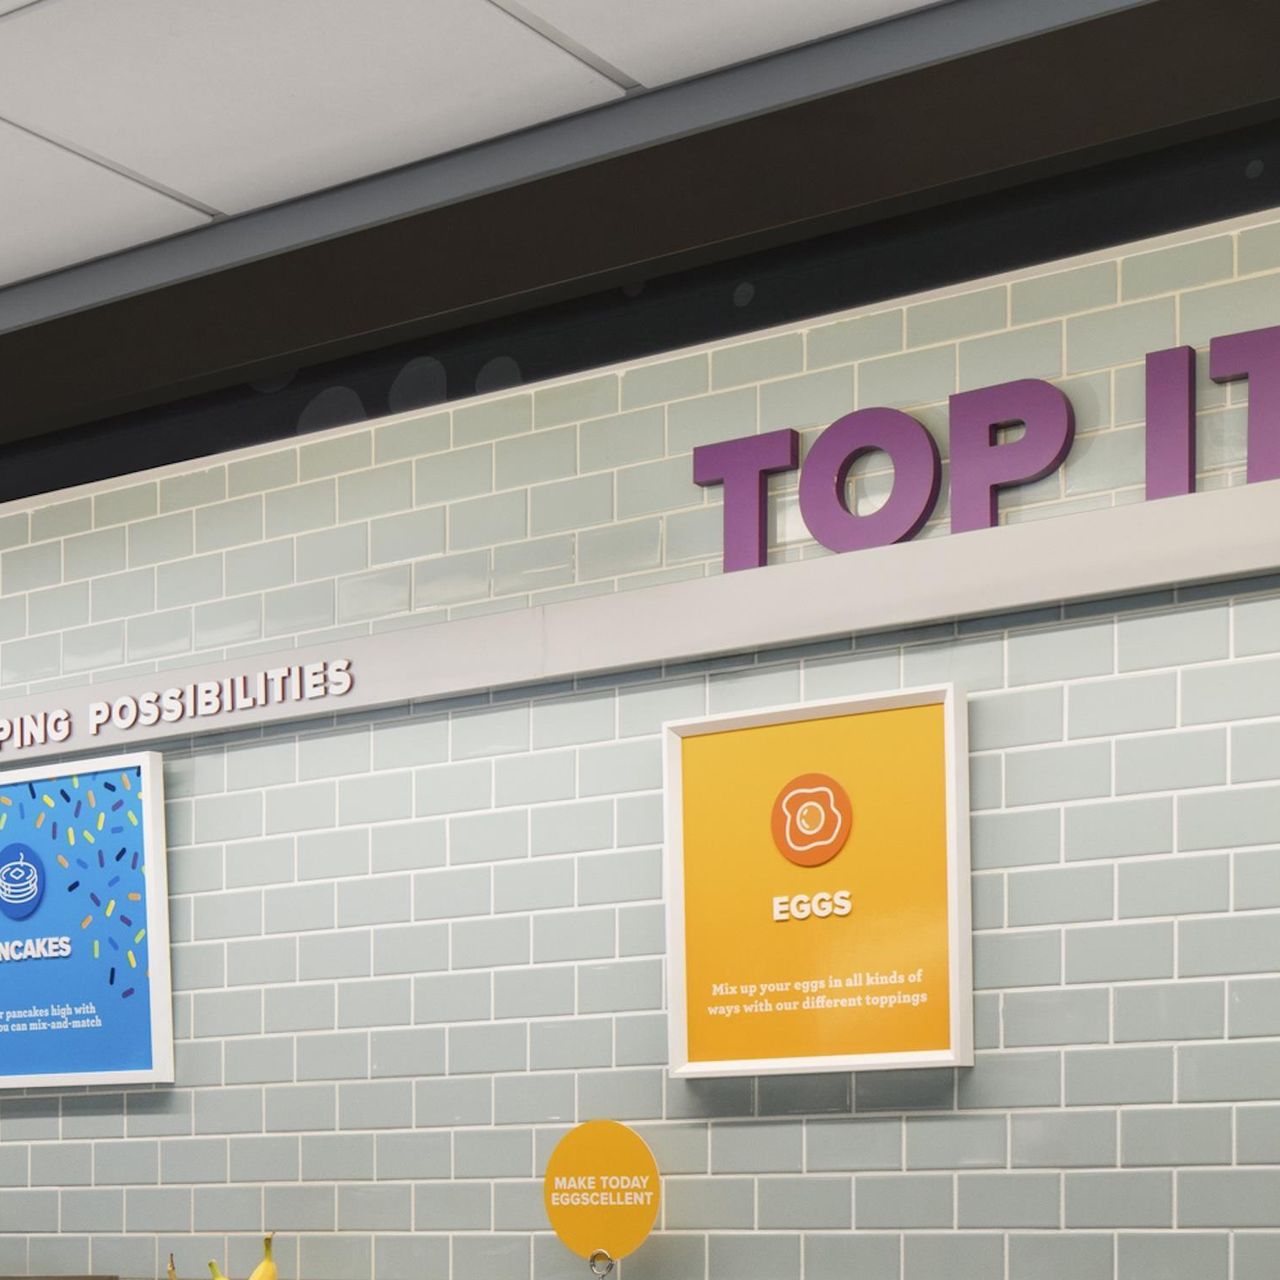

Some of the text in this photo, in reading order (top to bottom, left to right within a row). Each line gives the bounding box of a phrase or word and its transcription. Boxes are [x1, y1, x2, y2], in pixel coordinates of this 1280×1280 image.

[693, 378, 1077, 574] TOP
[88, 659, 355, 737] POSSIBILITIES
[772, 890, 853, 922] EGGS
[711, 968, 923, 996] Mix up your eggs in all kinds of
[6, 1005, 49, 1021] pancakes
[51, 1003, 73, 1018] high
[74, 1001, 96, 1015] with
[707, 990, 928, 1018] ways with our different toppings
[11, 1021, 28, 1031] can
[29, 1016, 103, 1031] mix-and-match
[554, 1175, 650, 1189] MAKE TODAY
[551, 1191, 654, 1206] EGGSCELLENT
